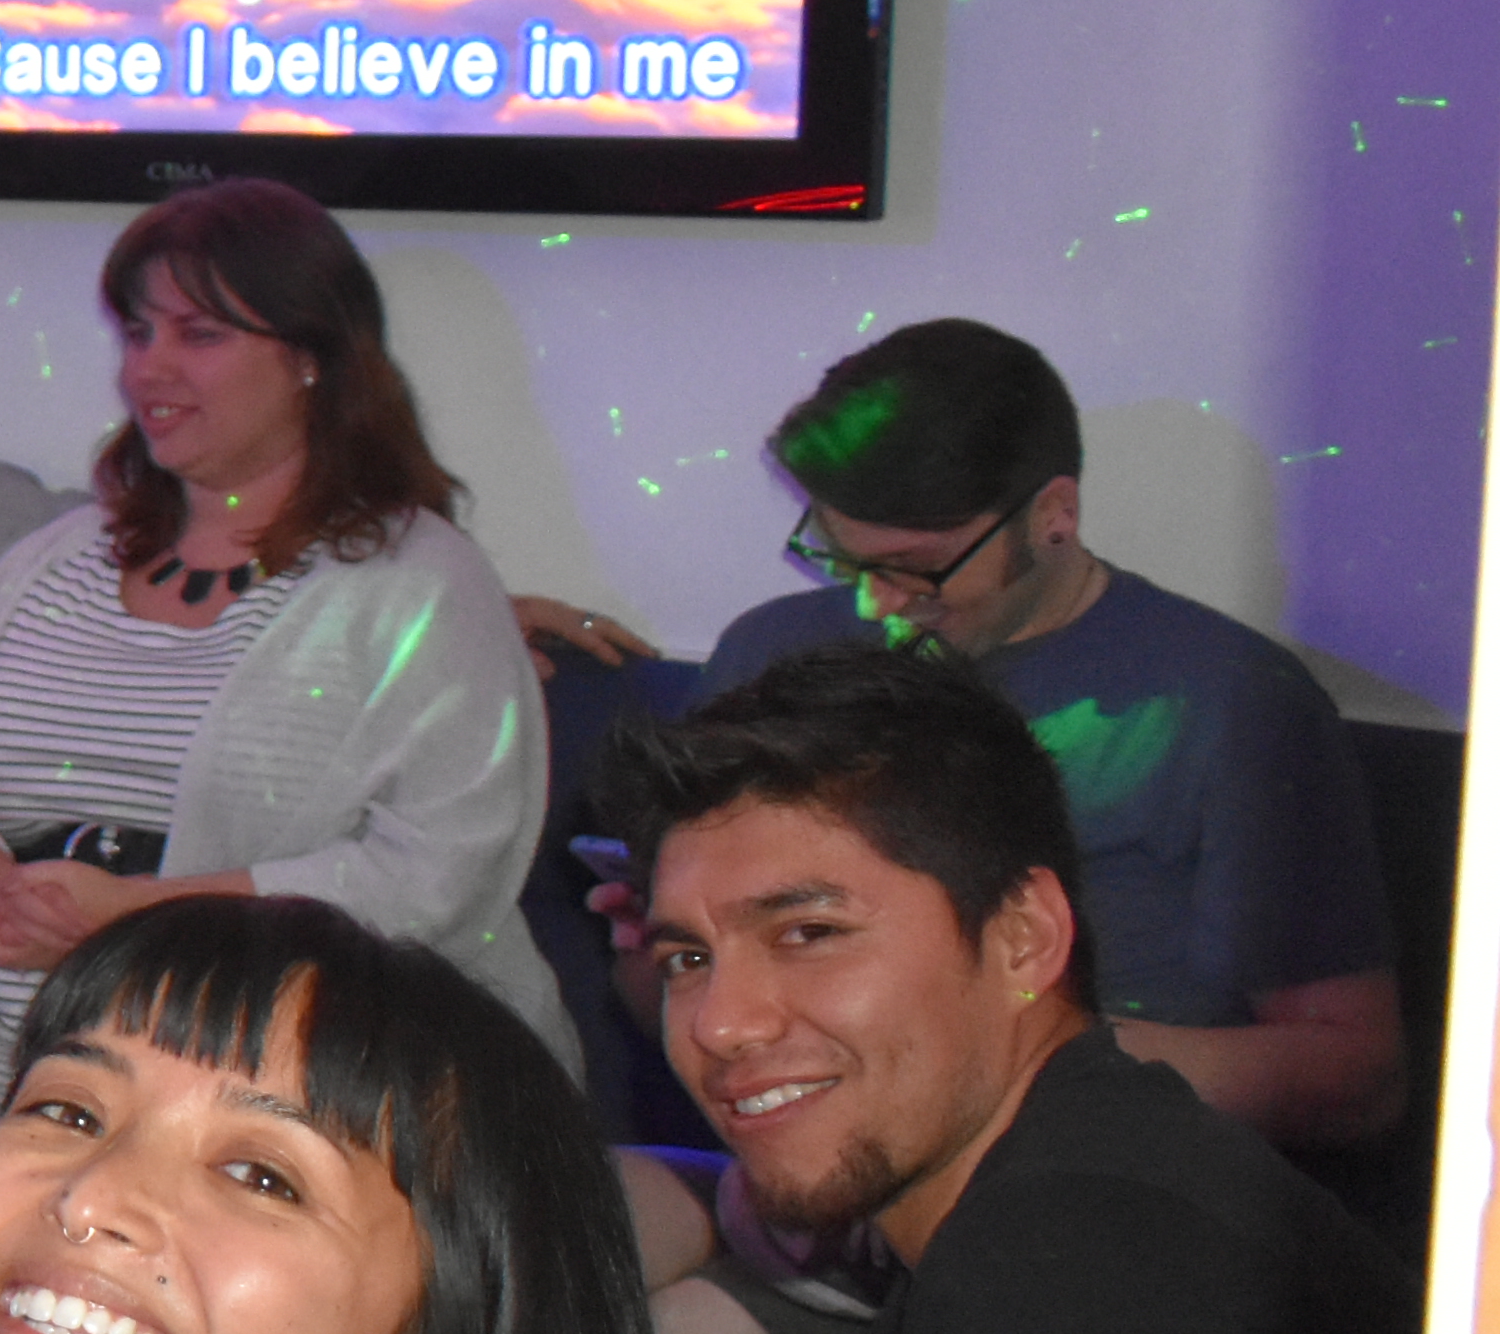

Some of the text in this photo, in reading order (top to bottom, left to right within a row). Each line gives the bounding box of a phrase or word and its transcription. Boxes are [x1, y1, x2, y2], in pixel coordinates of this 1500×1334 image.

[188, 27, 205, 95] I
[231, 26, 498, 96] believe
[527, 26, 593, 97] in
[623, 37, 740, 97] me
